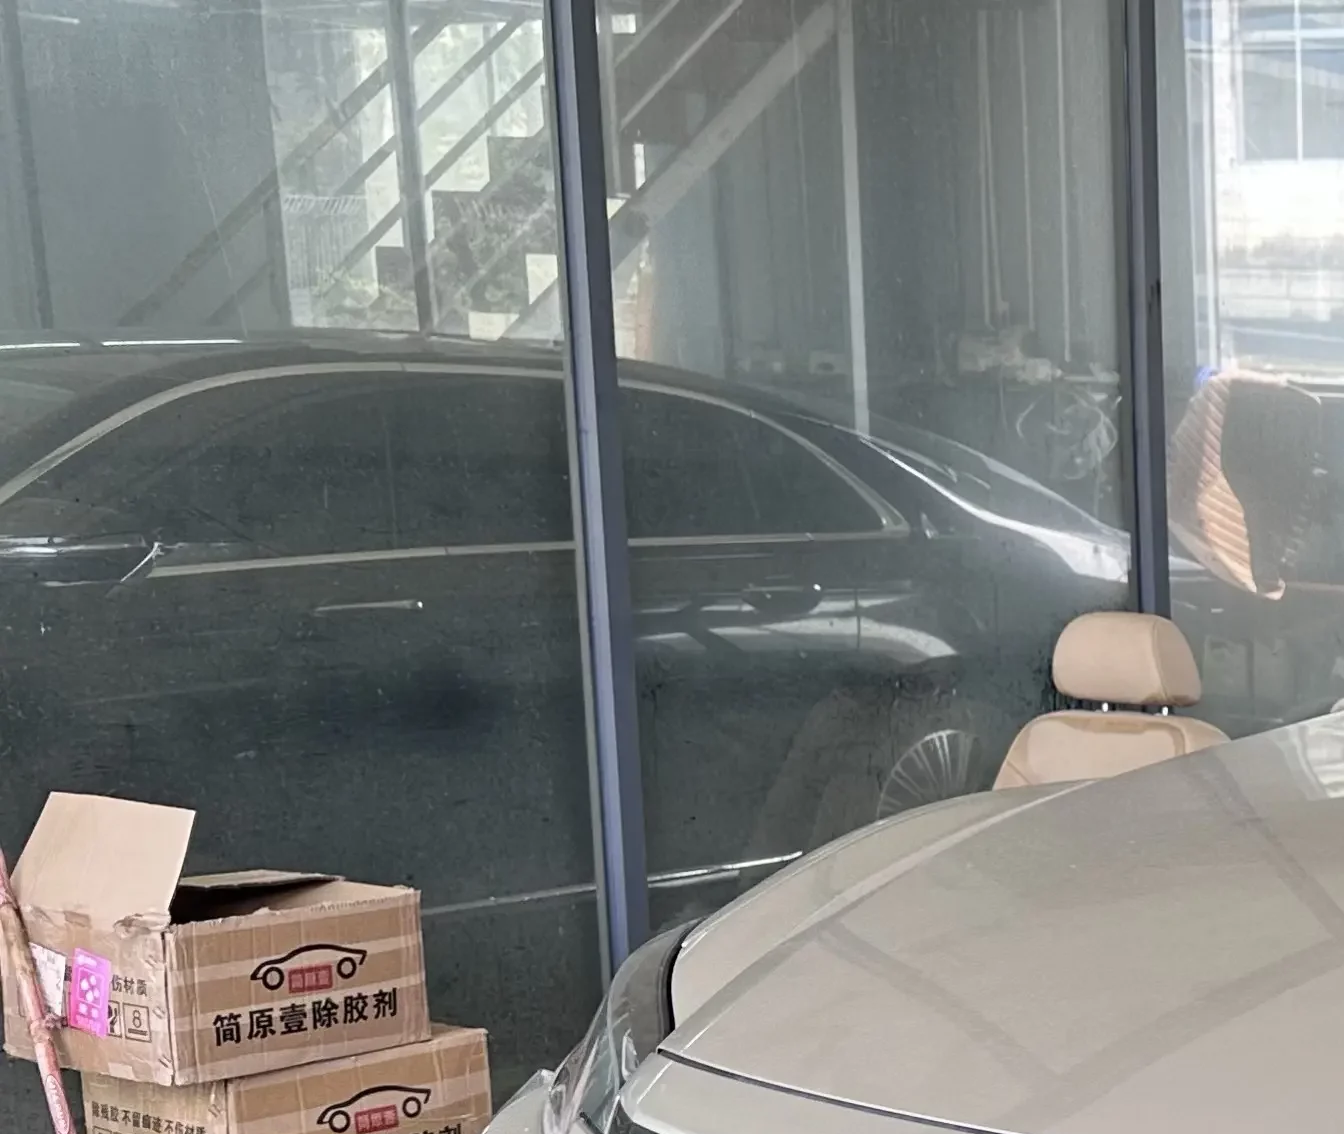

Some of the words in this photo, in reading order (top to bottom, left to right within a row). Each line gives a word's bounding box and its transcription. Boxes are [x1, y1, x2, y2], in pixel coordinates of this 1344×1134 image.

[213, 988, 398, 1046] 简原壹除胶剂
